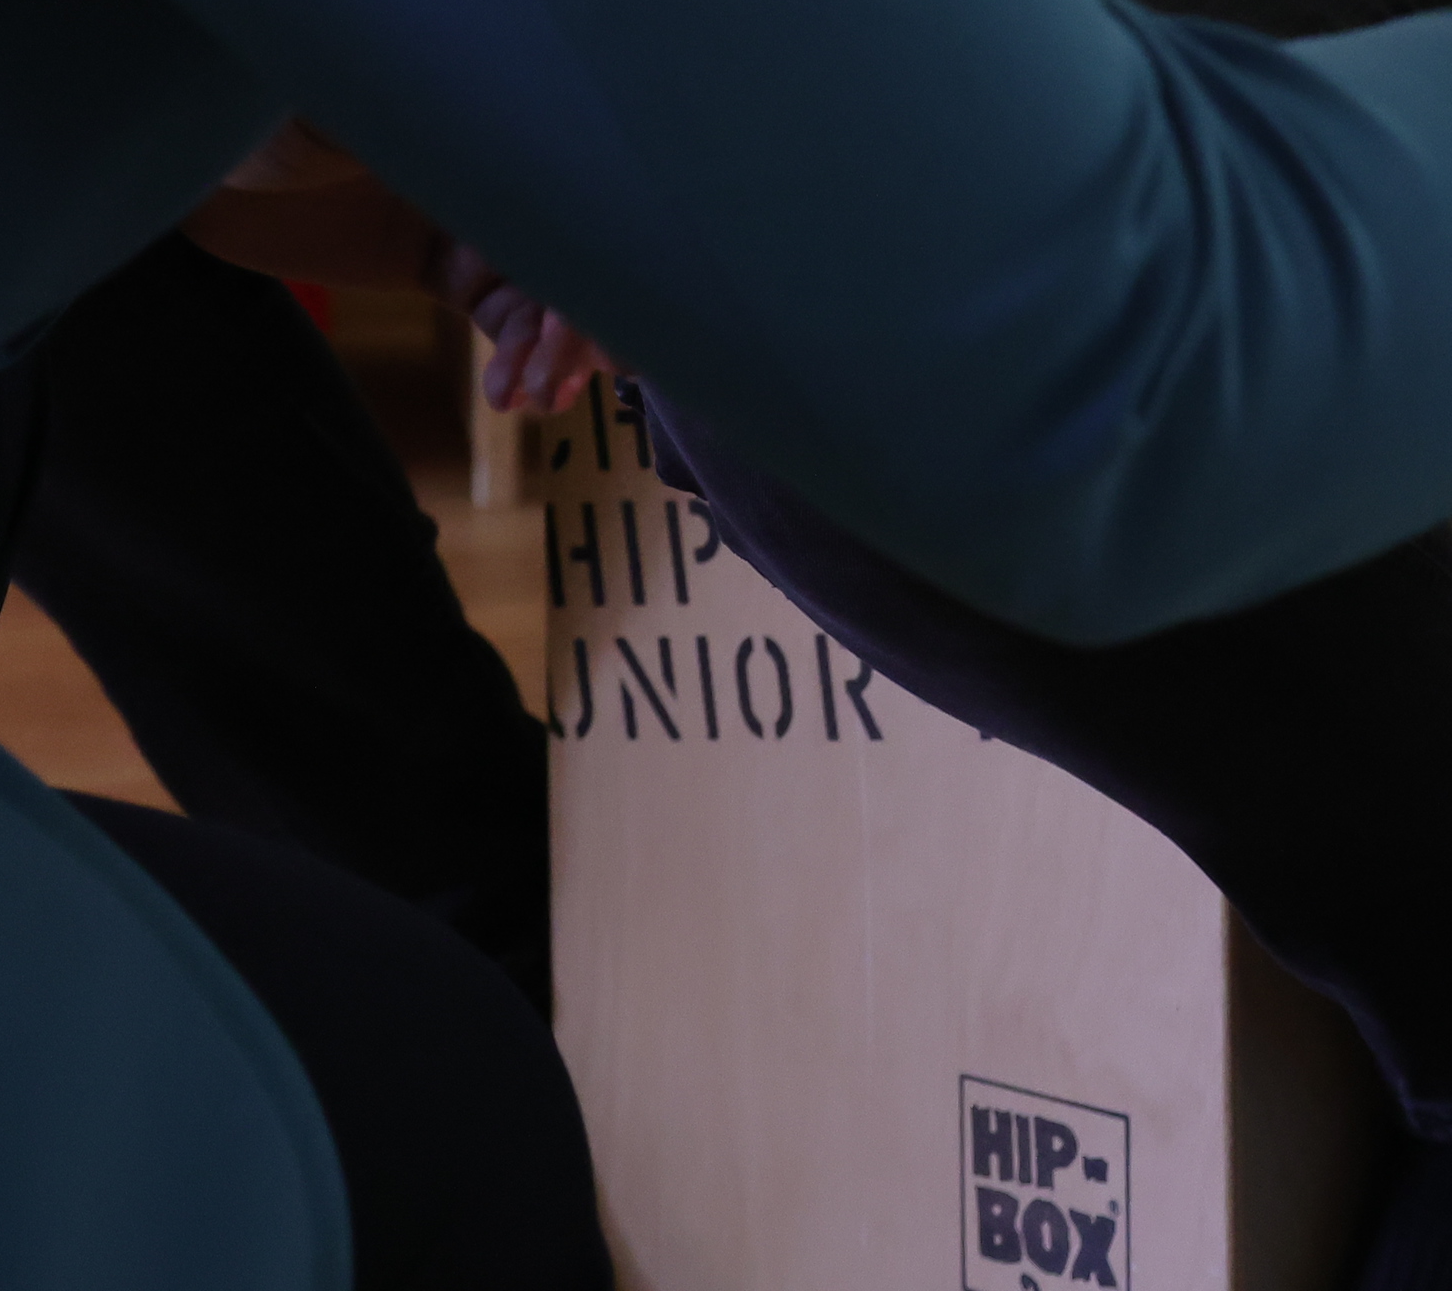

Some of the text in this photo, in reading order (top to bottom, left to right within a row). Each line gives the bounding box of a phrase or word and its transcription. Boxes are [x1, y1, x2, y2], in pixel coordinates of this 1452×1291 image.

[547, 499, 721, 607] HIP
[971, 1104, 1109, 1190] HIP-
[975, 1186, 1118, 1287] BOX
